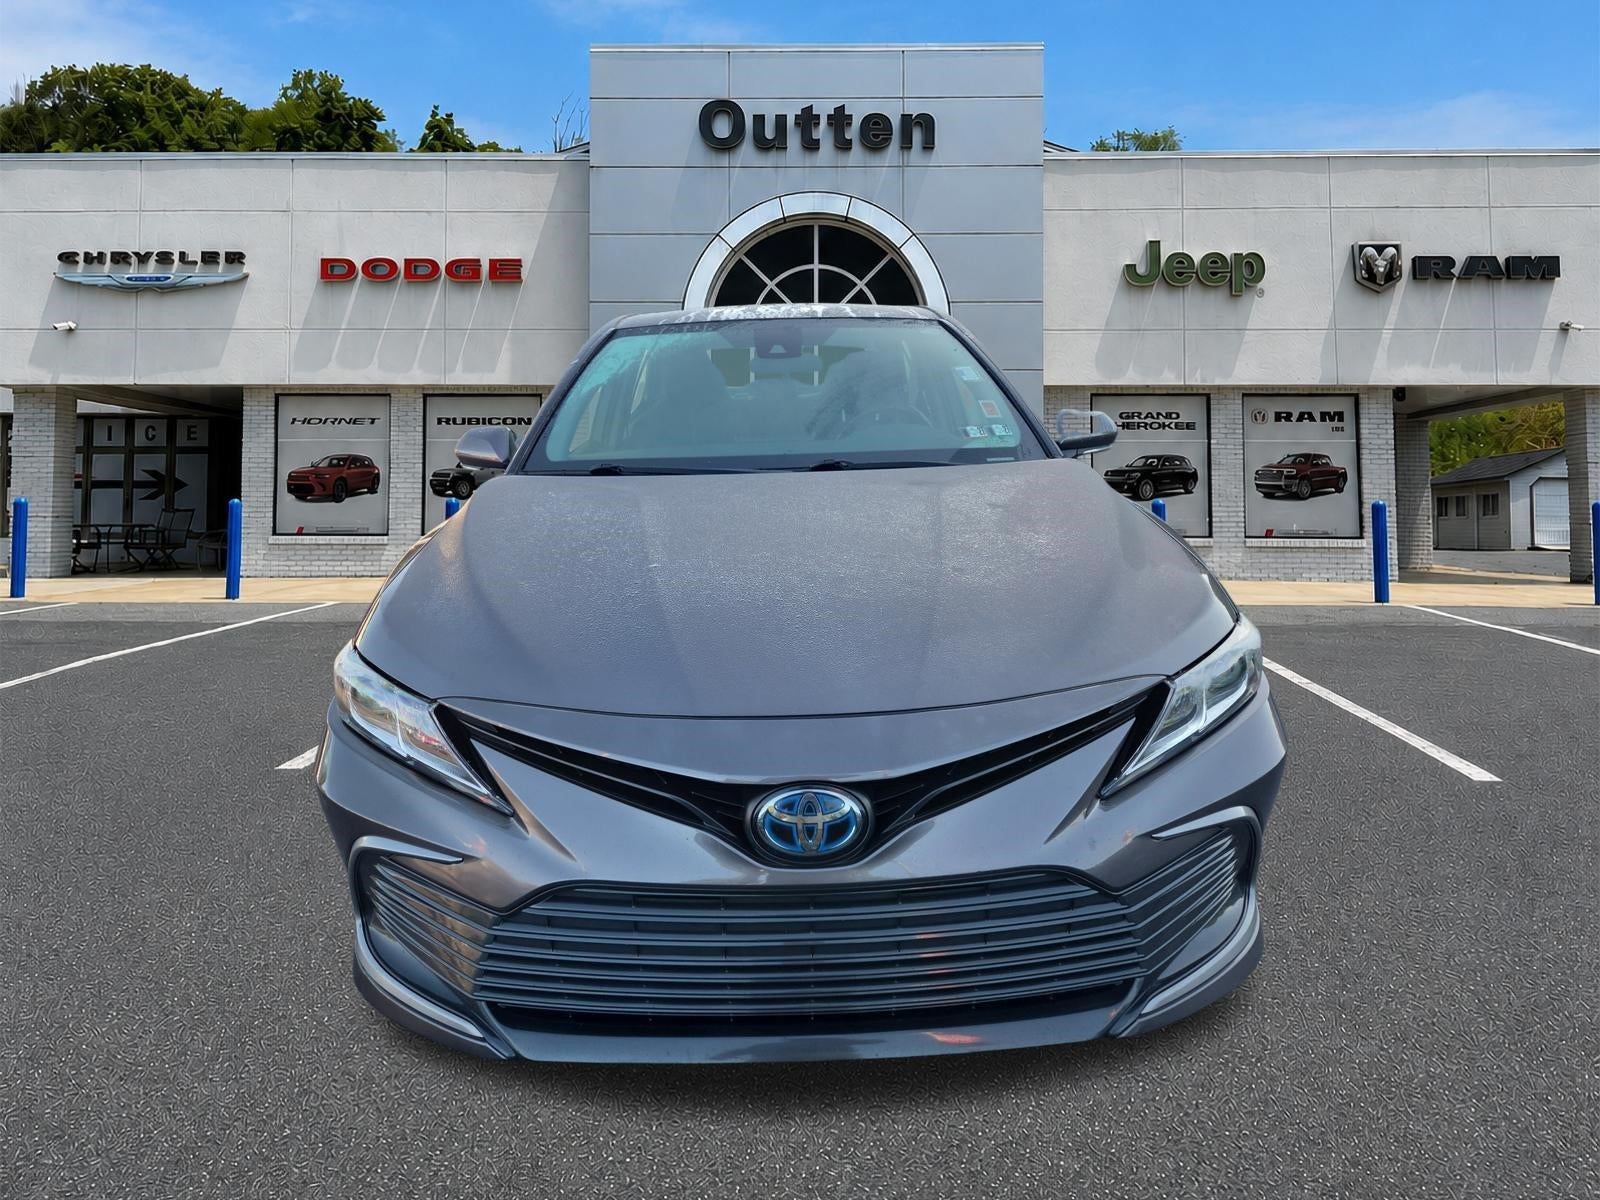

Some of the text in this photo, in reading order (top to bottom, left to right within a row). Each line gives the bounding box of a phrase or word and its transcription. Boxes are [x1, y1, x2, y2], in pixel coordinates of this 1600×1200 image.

[698, 99, 936, 150] Outten
[57, 250, 246, 265] CHRYSLER
[320, 257, 523, 282] DODGE
[1123, 240, 1266, 296] Jeep
[1412, 256, 1561, 280] RAM
[290, 417, 380, 425] HORNET
[436, 416, 532, 426] RUBICON
[1118, 411, 1180, 420] GRAND
[1274, 411, 1344, 422] RAM
[1114, 421, 1196, 430] HEROKEE
